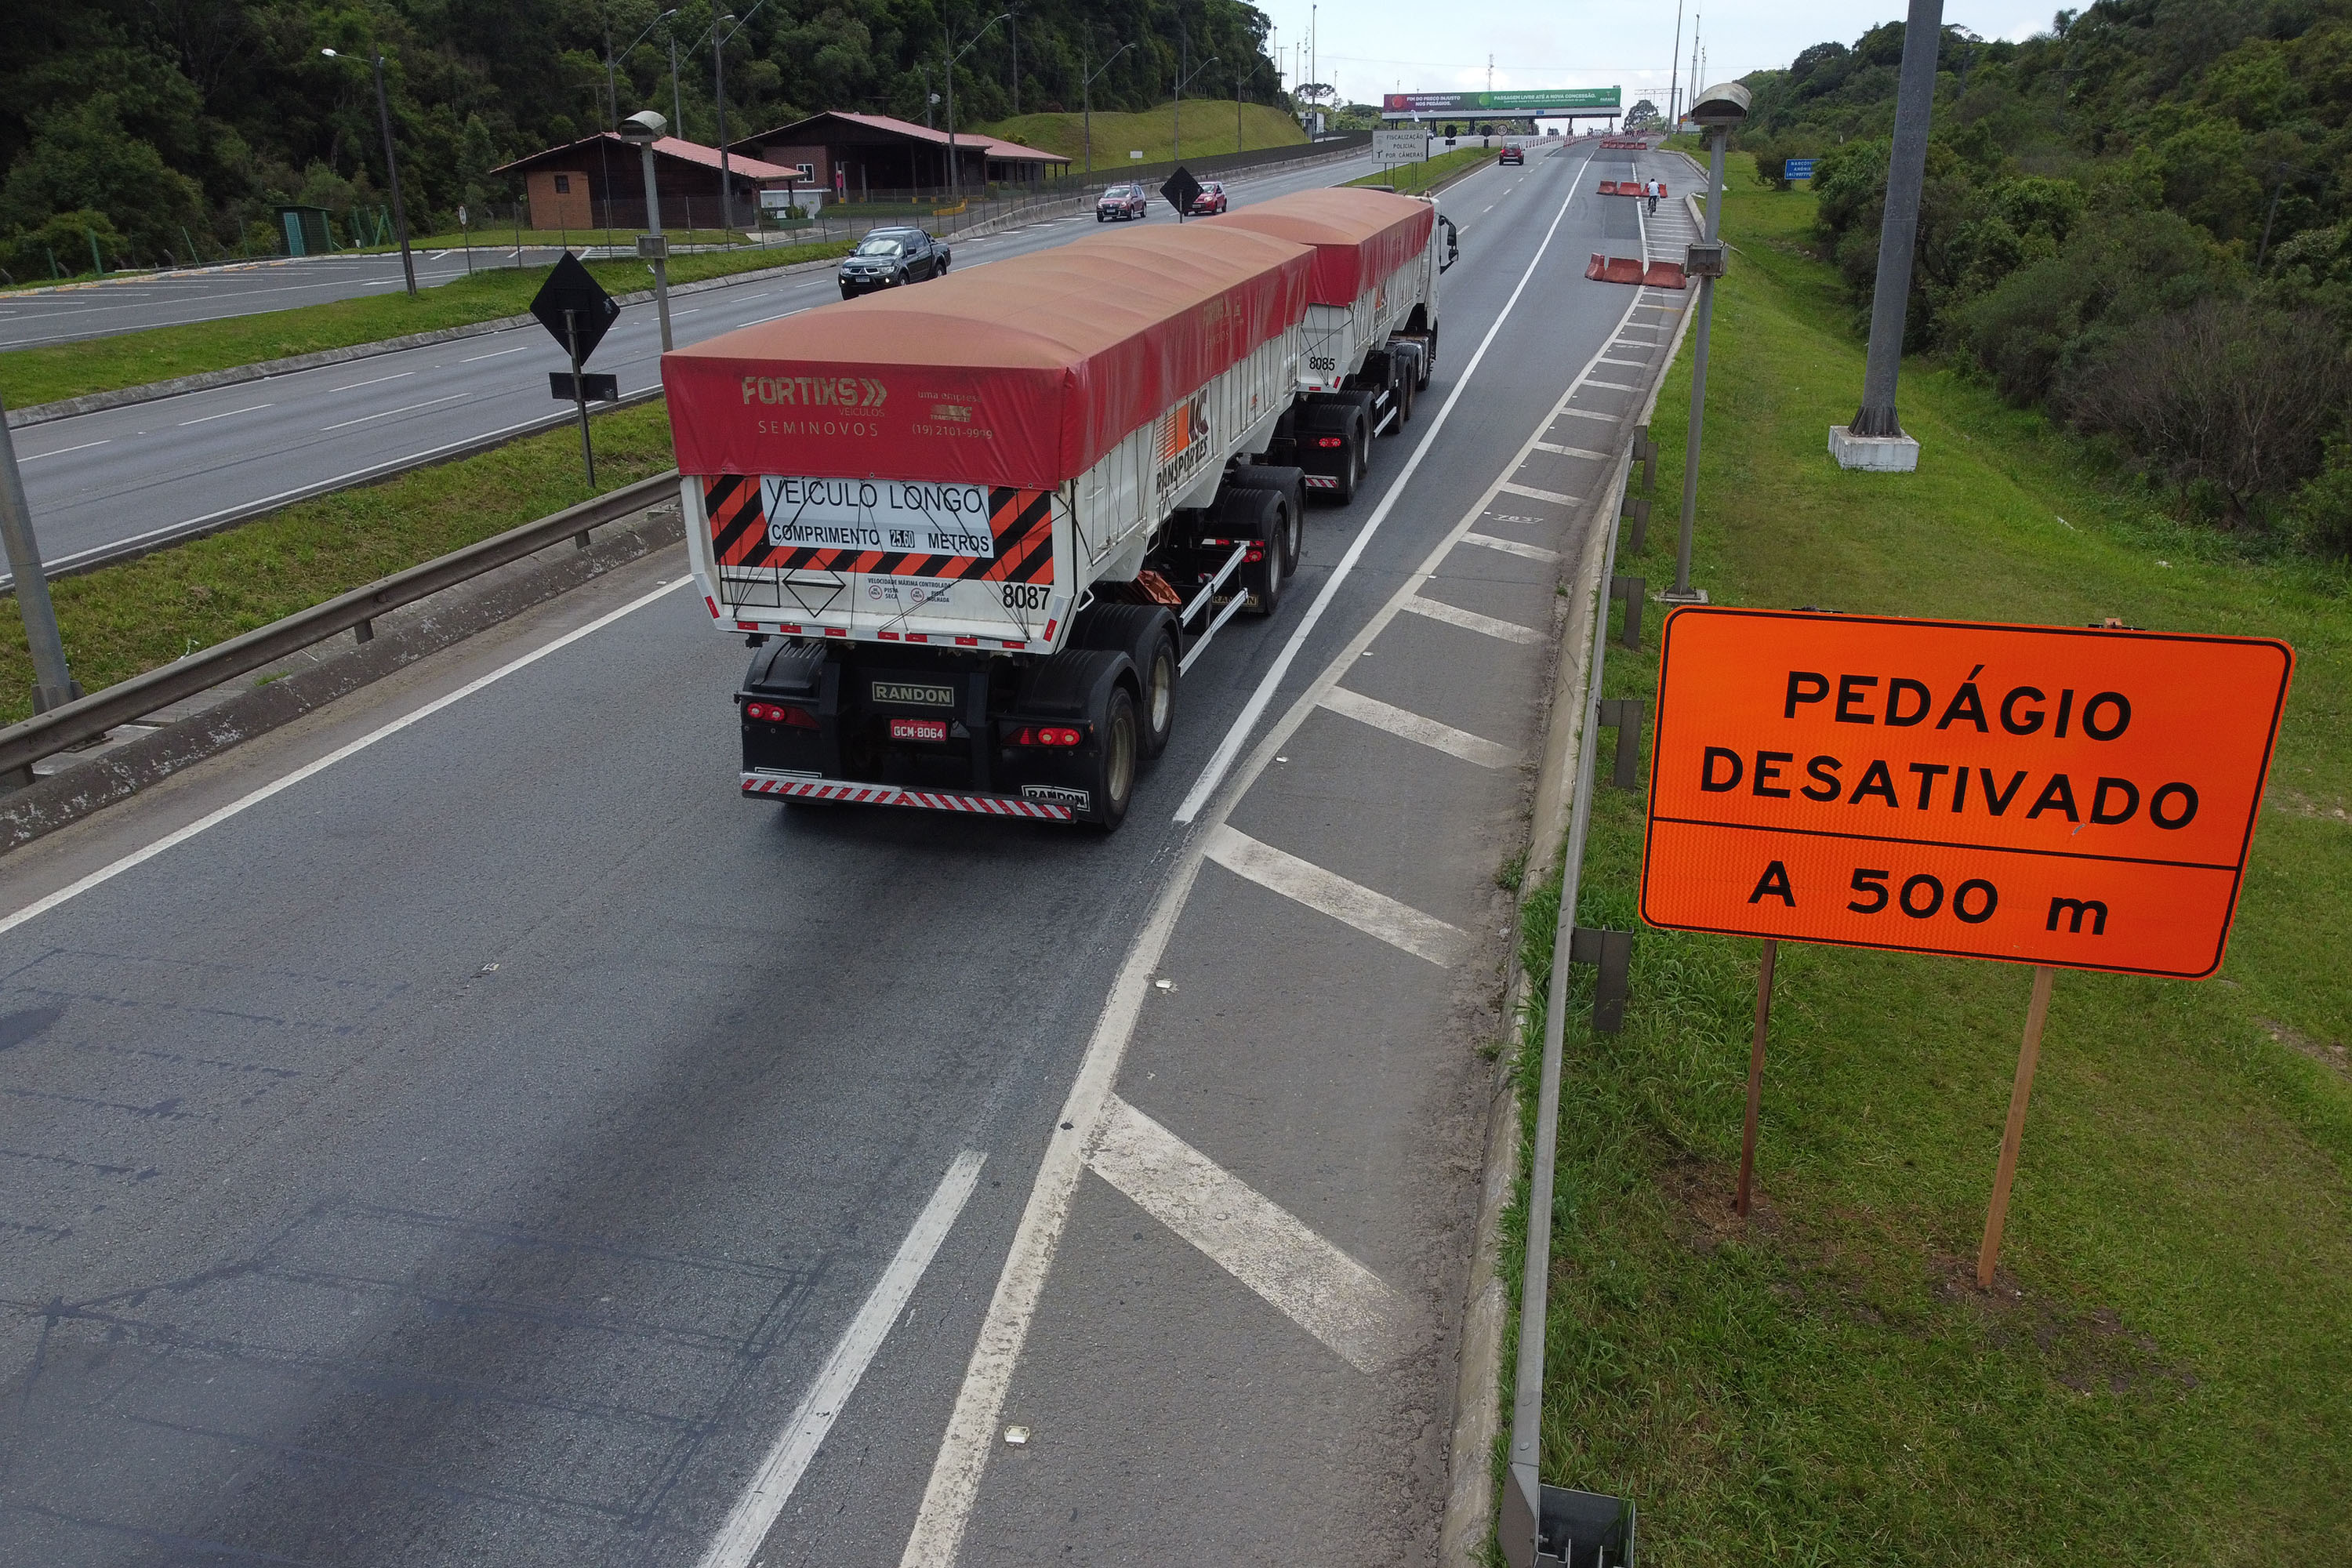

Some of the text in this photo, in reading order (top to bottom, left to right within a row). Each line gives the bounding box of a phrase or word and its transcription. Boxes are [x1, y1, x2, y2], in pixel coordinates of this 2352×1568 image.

[1309, 357, 1335, 371] 8085
[941, 393, 982, 403] empresa
[758, 420, 878, 437] SEMINOVOS
[913, 424, 932, 436] (19)
[767, 477, 982, 514] VEÍCULO LONGO
[771, 524, 989, 552] COMPRIMENTO 25.60 METROS
[1003, 585, 1051, 610] 8087
[876, 686, 950, 702] RANDON
[1784, 664, 2132, 742] PEDÁGIO
[1700, 746, 2199, 830] DESATIVADO
[1748, 860, 2108, 935] A 500 m
